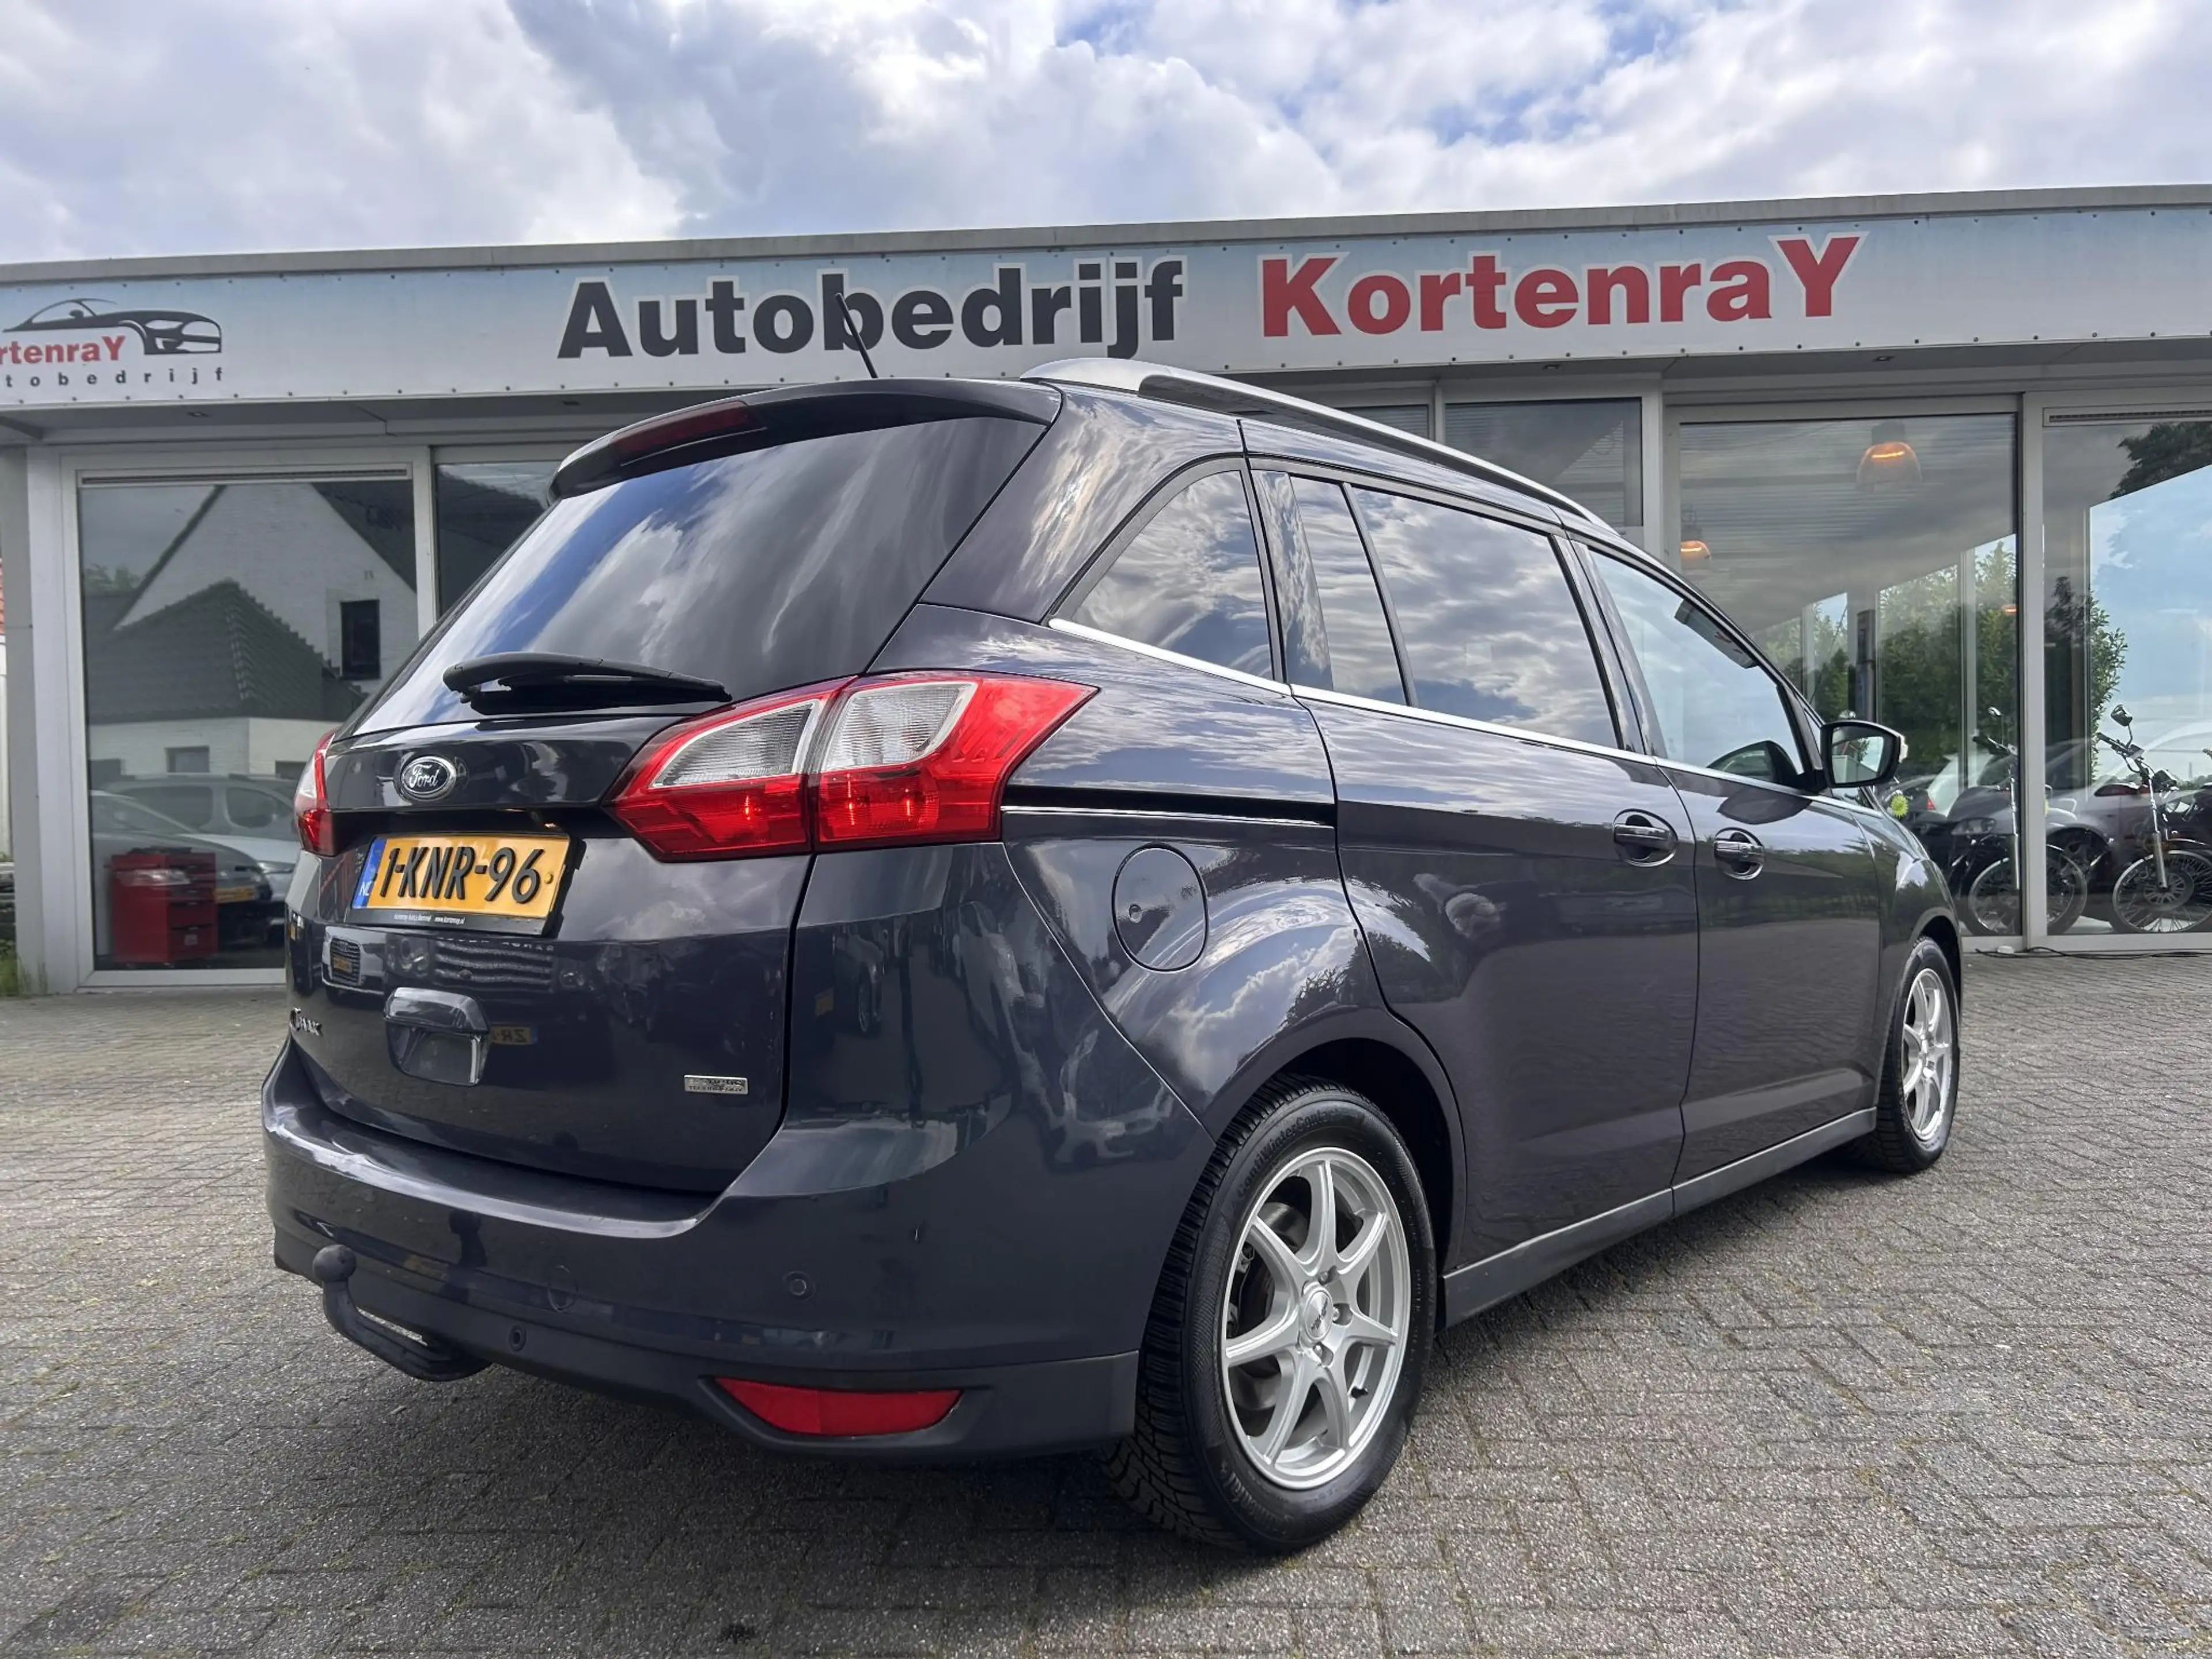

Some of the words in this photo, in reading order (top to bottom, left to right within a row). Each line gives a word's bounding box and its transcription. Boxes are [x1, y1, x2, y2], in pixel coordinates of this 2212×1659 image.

[556, 260, 1183, 358] Autobedrijf
[1262, 236, 1861, 338] KortenraY
[409, 764, 440, 788] Ford
[379, 845, 546, 905] 1-KNR-96
